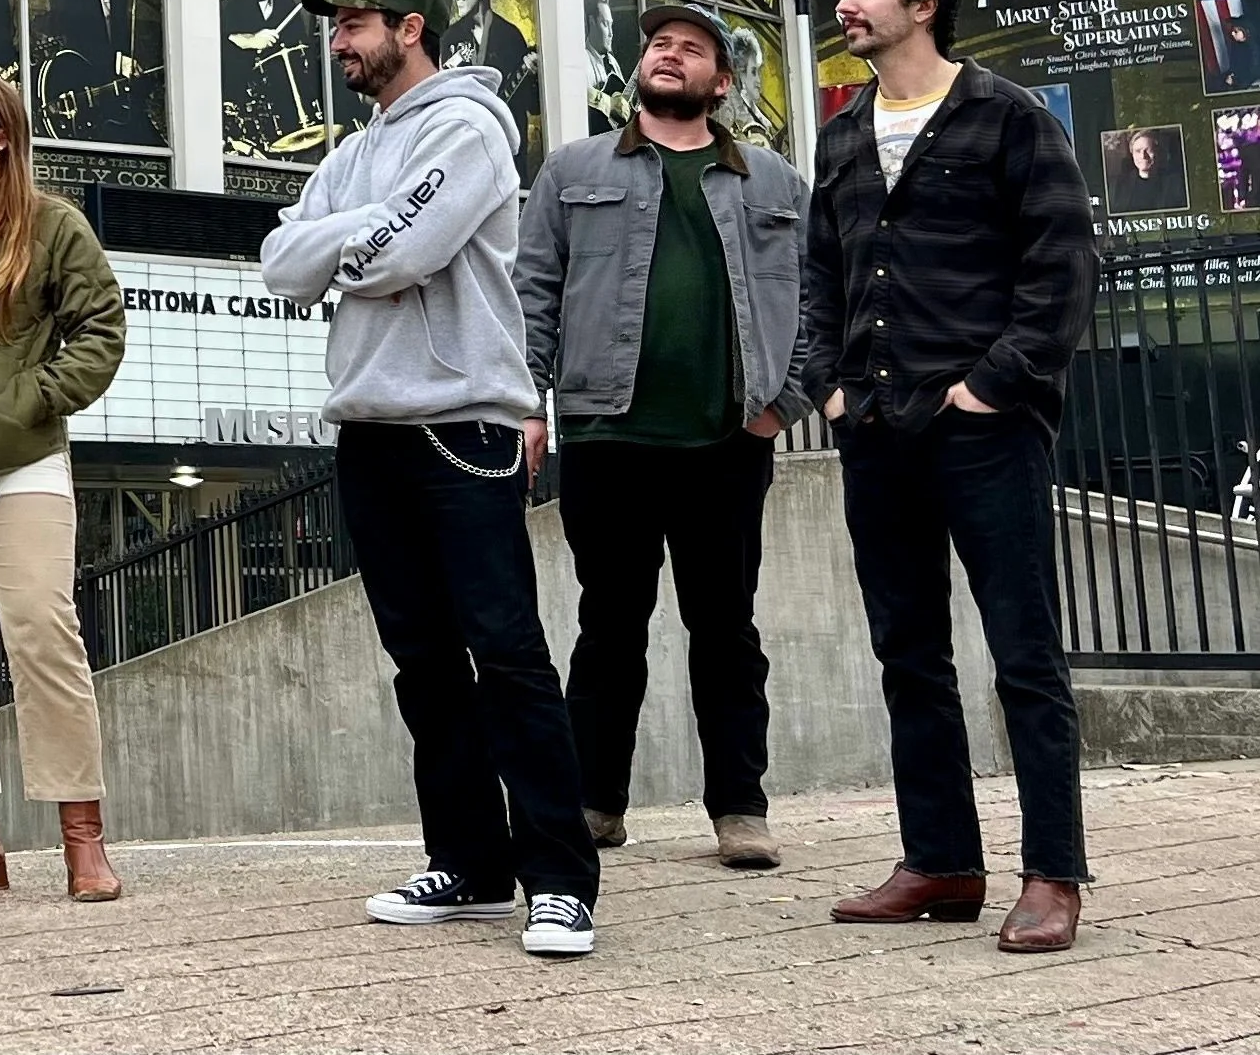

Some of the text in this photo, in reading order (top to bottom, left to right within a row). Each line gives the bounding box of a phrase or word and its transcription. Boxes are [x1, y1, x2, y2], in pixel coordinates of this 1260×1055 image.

[995, 5, 1052, 28] MARTY
[1050, 3, 1188, 36] & THE FABULOUS
[1062, 20, 1182, 52] SUPERLATIVES
[33, 165, 167, 188] BILLY COX
[108, 158, 137, 168] THE
[124, 287, 312, 321] ERTOMA CASINO
[205, 408, 340, 444] MUSEU
